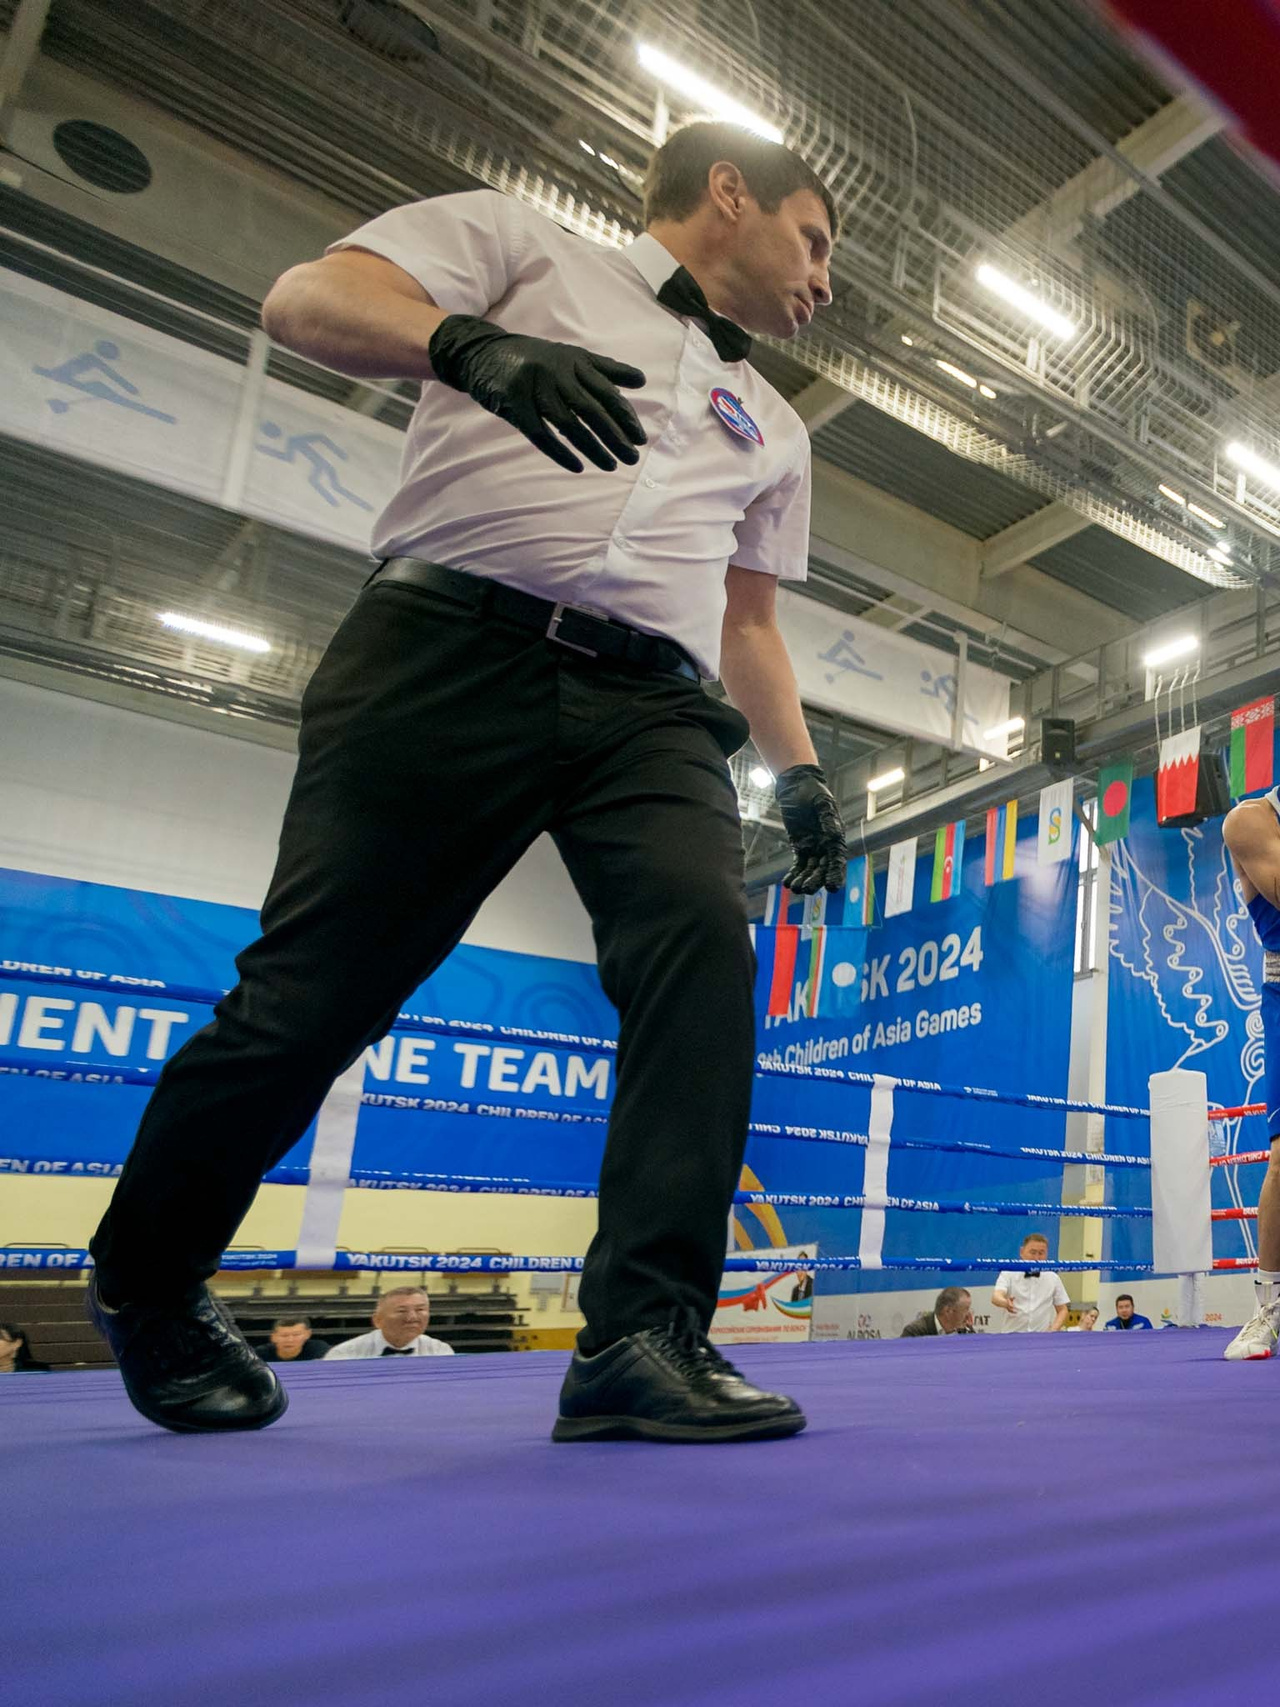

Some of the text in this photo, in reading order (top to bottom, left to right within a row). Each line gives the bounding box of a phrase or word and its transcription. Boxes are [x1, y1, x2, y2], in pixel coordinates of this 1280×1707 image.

[897, 925, 984, 993] 2024
[784, 1031, 849, 1067] Children
[851, 1024, 871, 1055] of
[872, 1016, 912, 1050] Asia
[915, 1002, 982, 1039] Games
[453, 1042, 610, 1100] TEAM
[423, 1099, 470, 1114] 2024
[750, 1194, 807, 1207] YAKUTSK
[808, 1197, 840, 1208] 2024
[346, 1252, 433, 1269] YAKUTSK
[436, 1256, 482, 1269] 2024
[488, 1257, 574, 1270] CHILDREN
[1204, 1314, 1223, 1322] 2024
